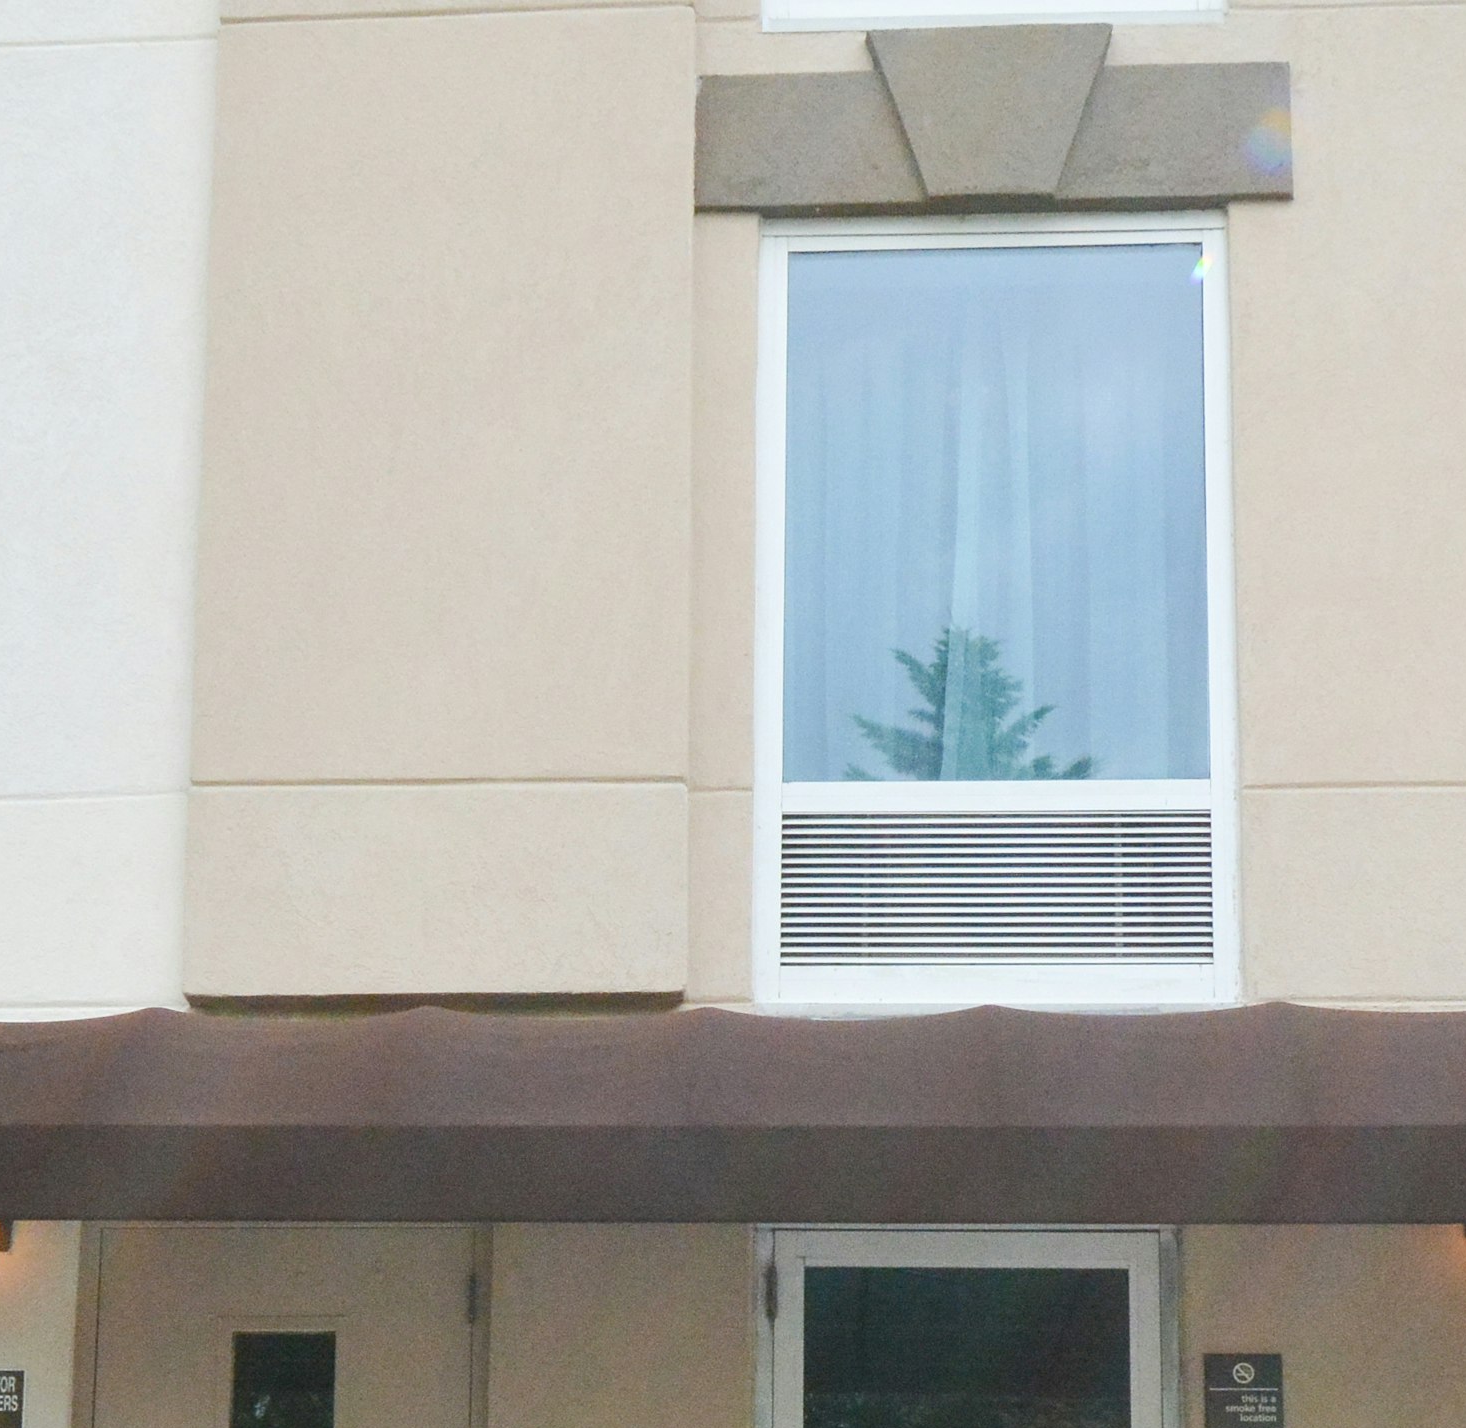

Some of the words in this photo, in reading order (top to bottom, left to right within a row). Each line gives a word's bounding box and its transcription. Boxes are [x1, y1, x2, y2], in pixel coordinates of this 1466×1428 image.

[1242, 1394, 1258, 1403] this
[1261, 1394, 1268, 1403] is
[1226, 1404, 1255, 1413] smoke
[1258, 1404, 1276, 1413] free
[1240, 1413, 1276, 1422] location
